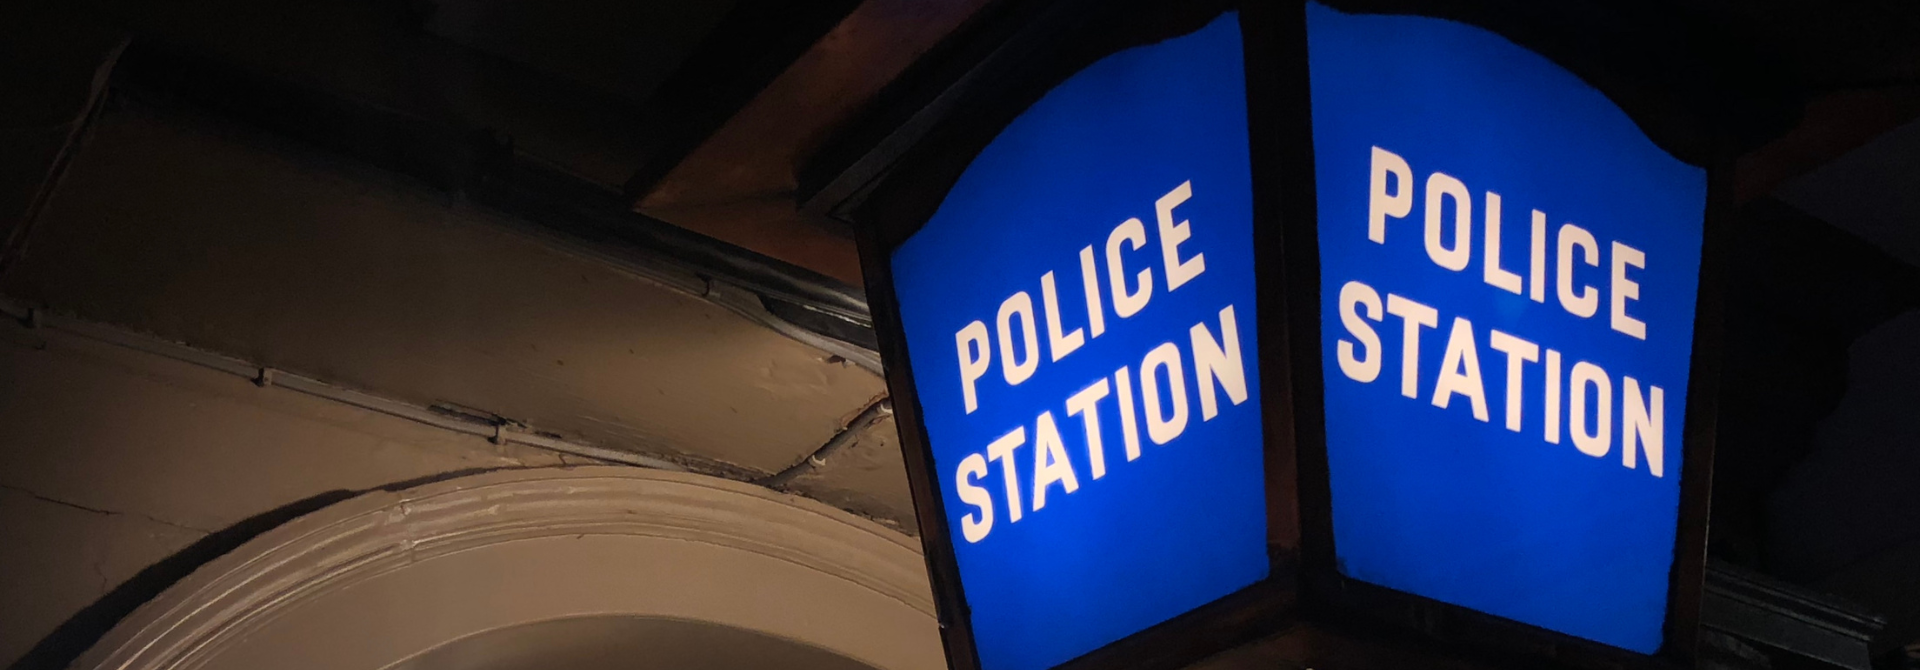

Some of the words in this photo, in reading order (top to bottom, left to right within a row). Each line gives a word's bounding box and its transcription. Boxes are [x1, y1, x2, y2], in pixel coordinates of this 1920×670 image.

[955, 180, 1206, 415] POLICE
[1368, 145, 1647, 340] POLICE
[954, 304, 1248, 544] STATION
[1337, 280, 1665, 478] STATION
